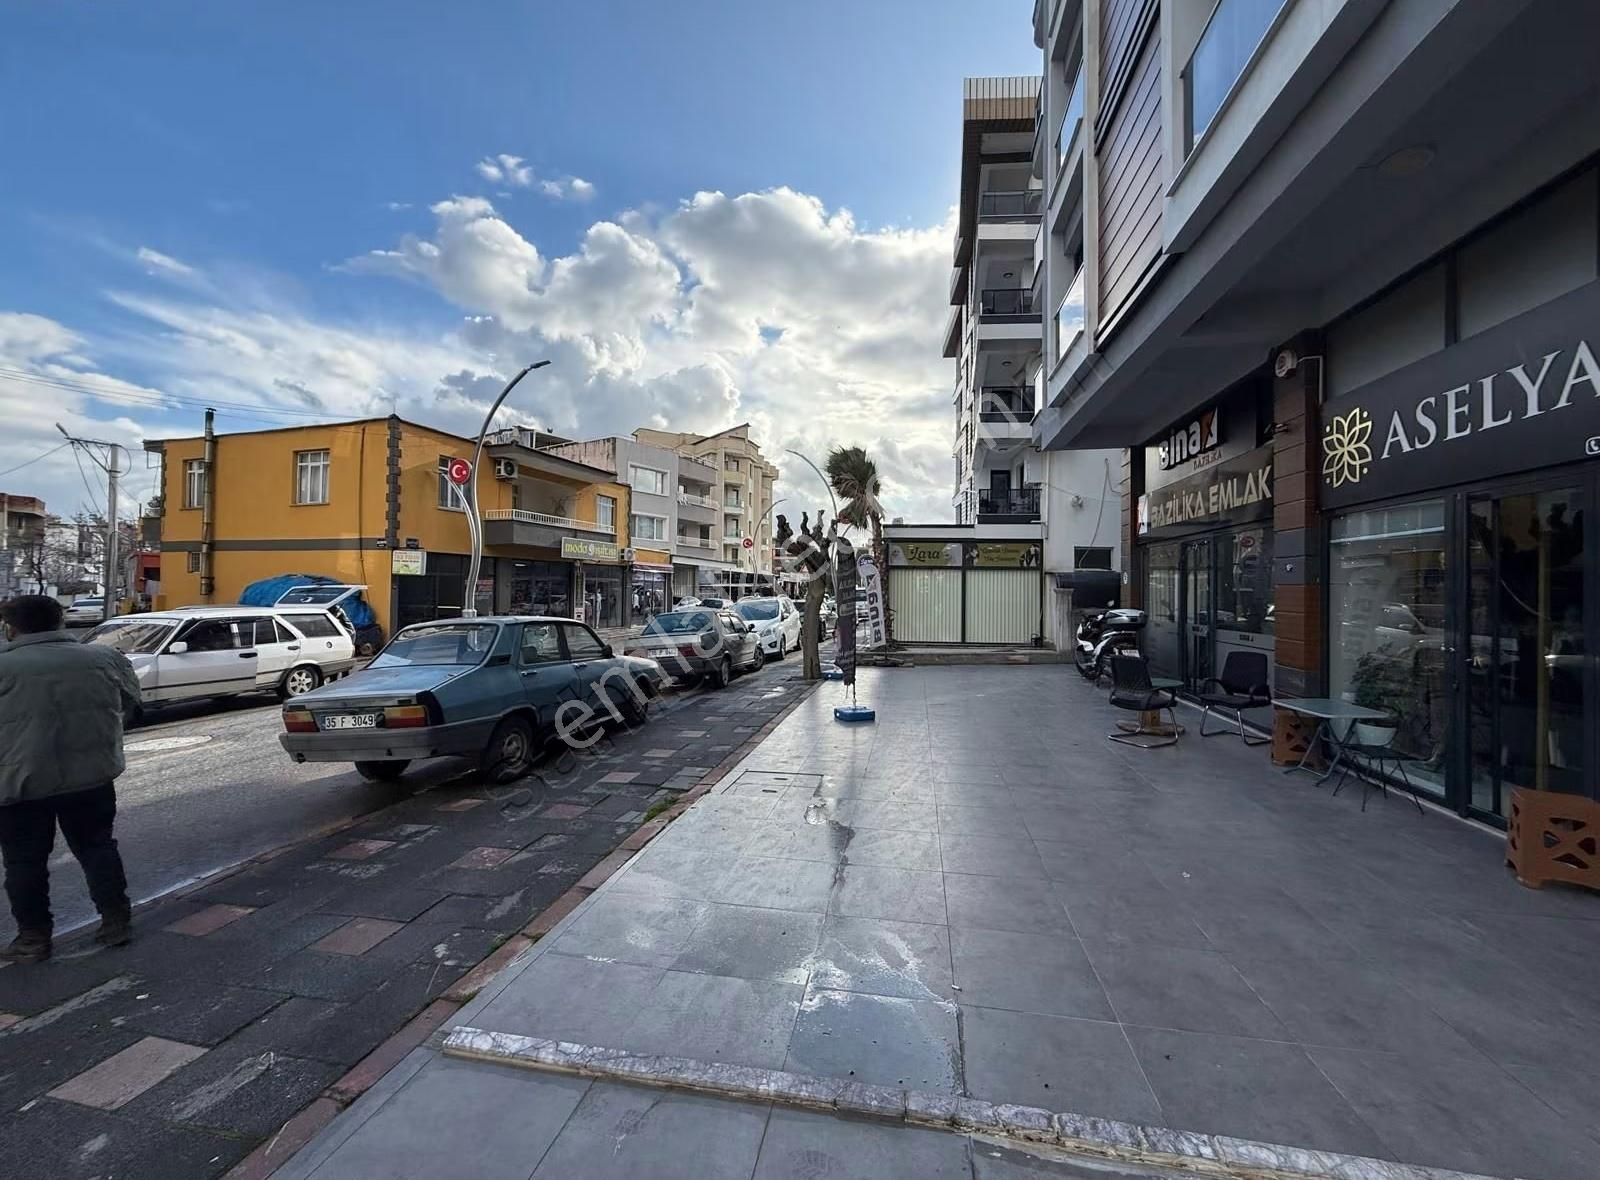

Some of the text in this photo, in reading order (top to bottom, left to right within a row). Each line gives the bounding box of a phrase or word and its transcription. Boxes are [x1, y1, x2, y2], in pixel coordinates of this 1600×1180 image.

[1381, 340, 1600, 459] ASELYA
[1209, 464, 1273, 514] EMLAK
[907, 547, 940, 562] Lara
[326, 715, 374, 728] 35 F 3049
